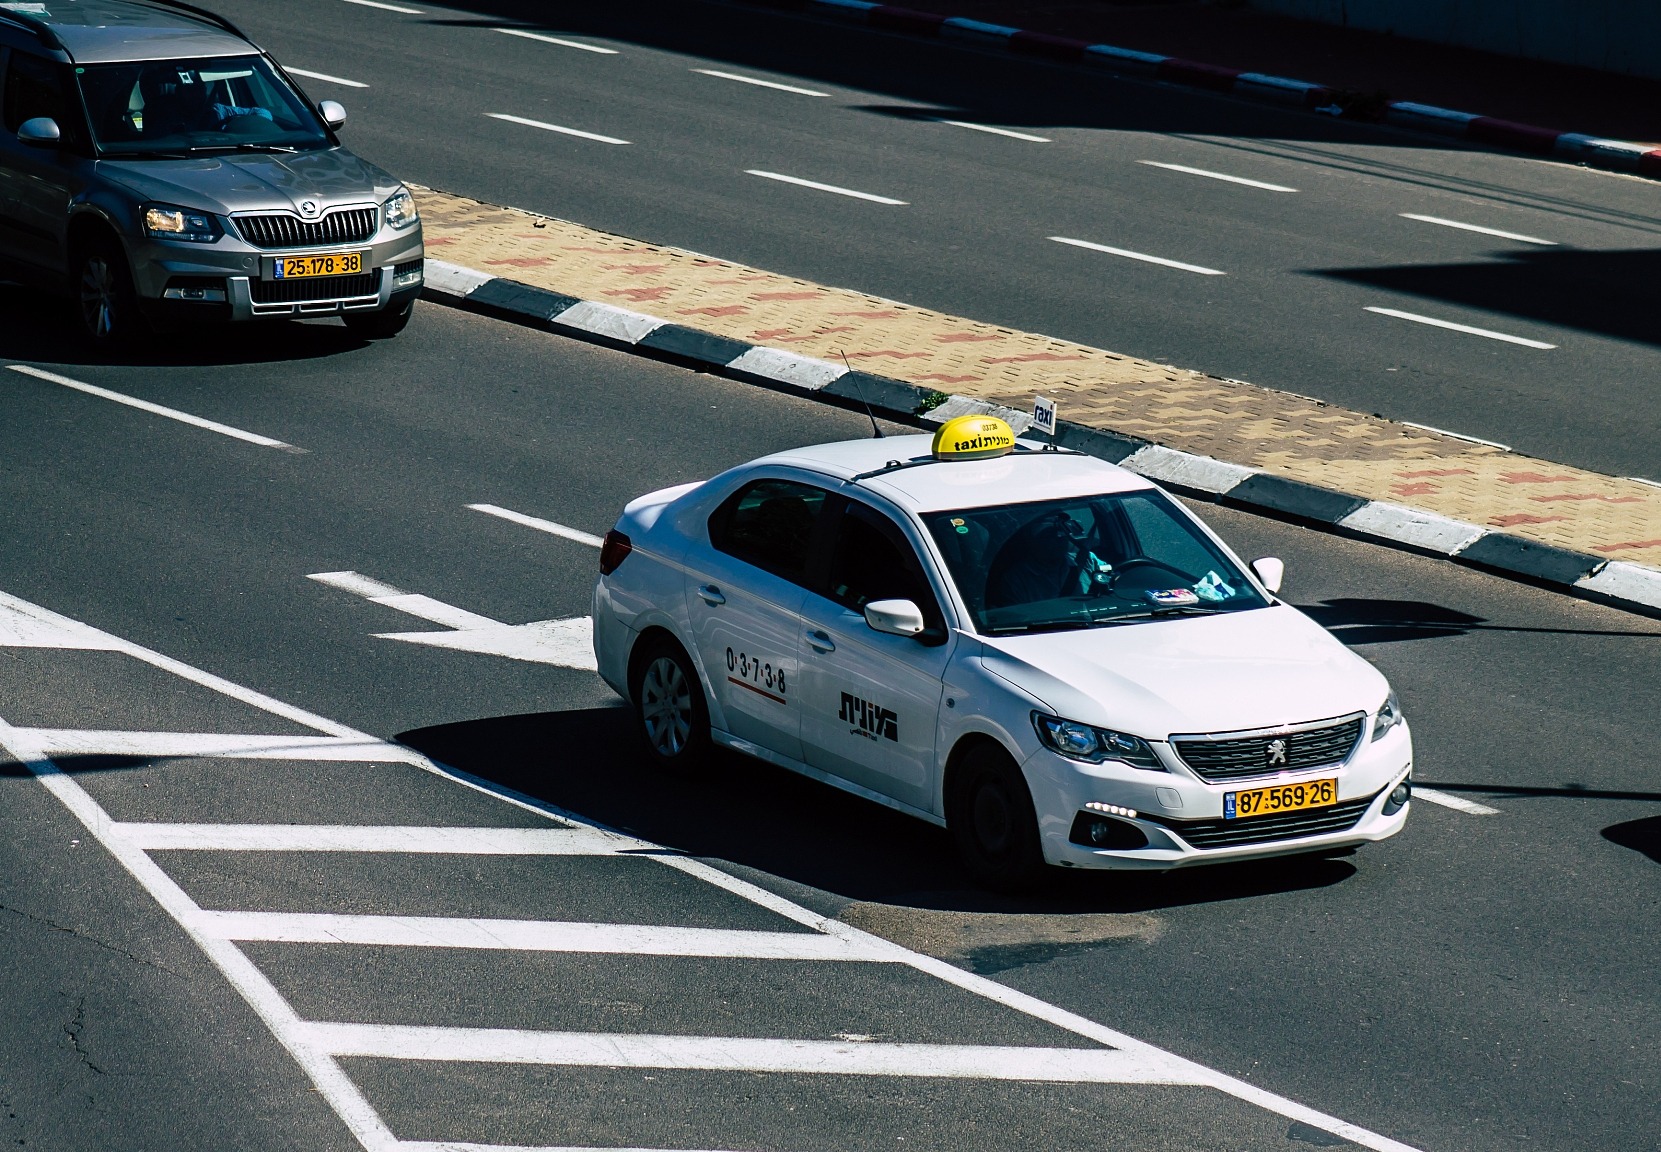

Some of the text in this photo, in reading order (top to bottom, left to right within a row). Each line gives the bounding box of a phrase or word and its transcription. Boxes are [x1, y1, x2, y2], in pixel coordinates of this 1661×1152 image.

[954, 434, 982, 451] taxi
[983, 436, 1010, 447] מונית
[838, 691, 898, 742] מונית
